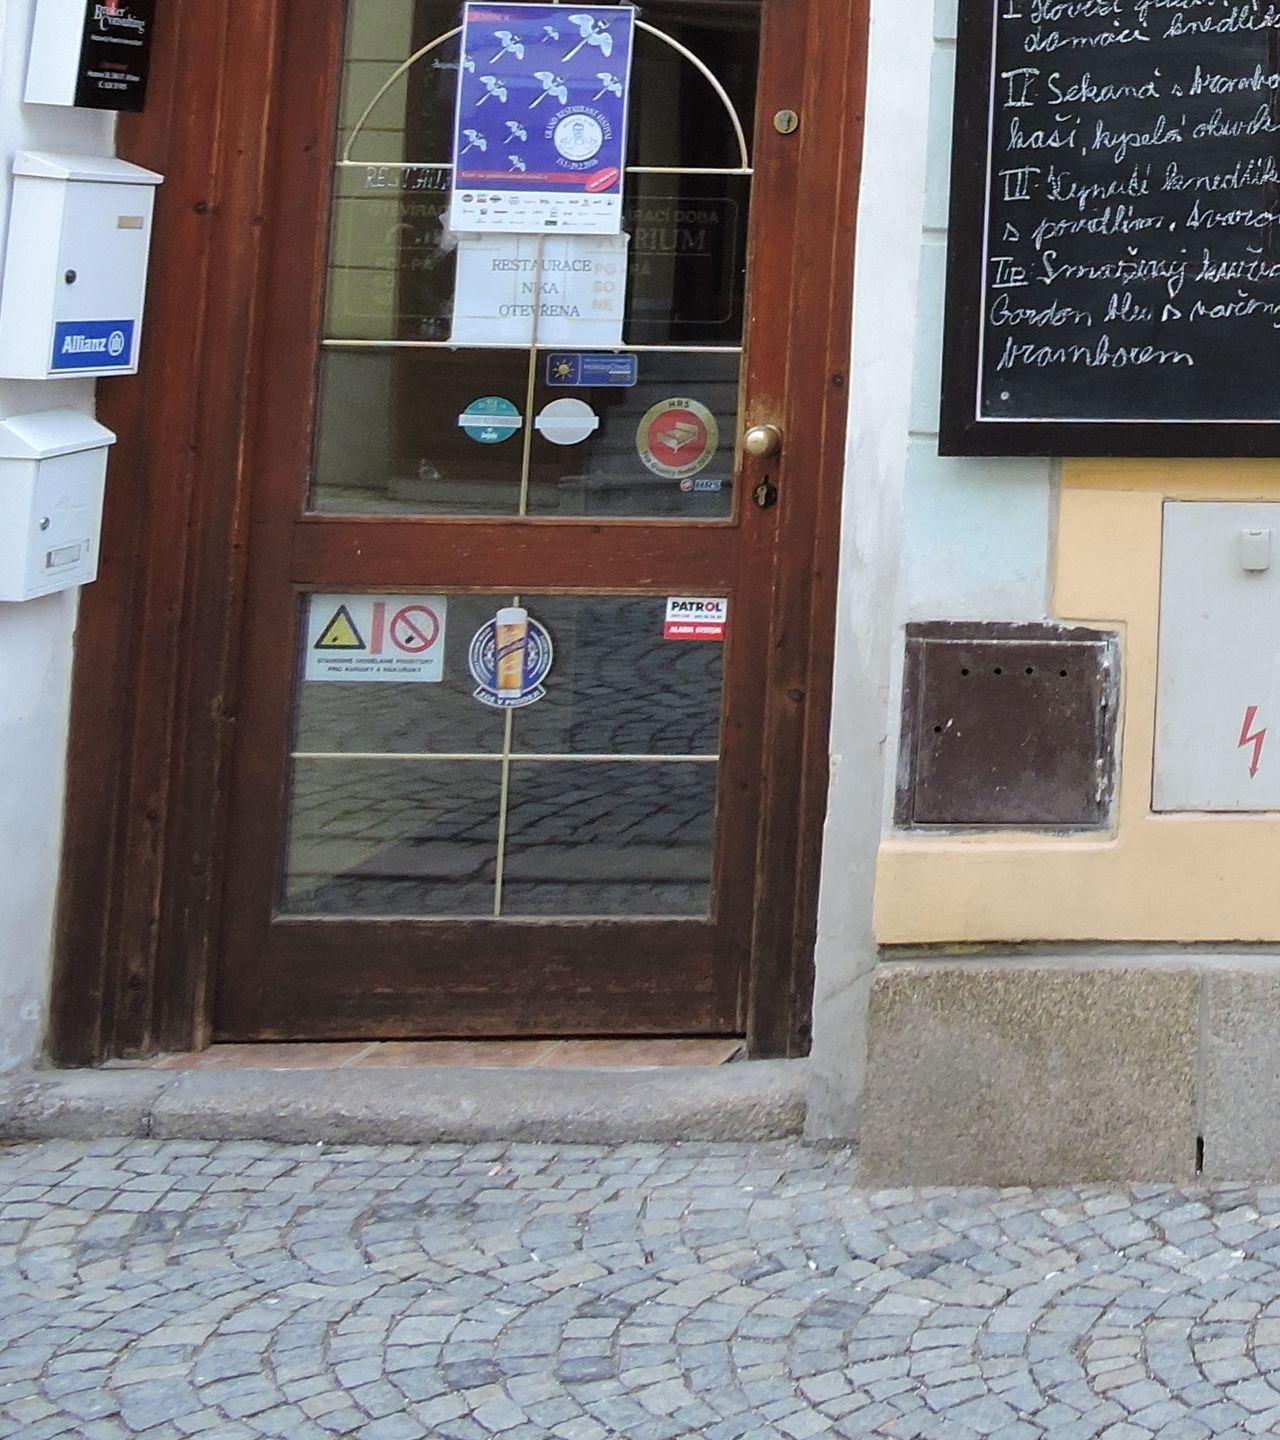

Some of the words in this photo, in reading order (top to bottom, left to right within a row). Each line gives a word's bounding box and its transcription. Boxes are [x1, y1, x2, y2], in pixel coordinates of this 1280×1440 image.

[491, 259, 593, 273] RESTAURACE
[521, 281, 559, 295] NKA
[61, 334, 107, 354] Allianz
[668, 401, 690, 409] HRS
[671, 601, 723, 613] PATROL
